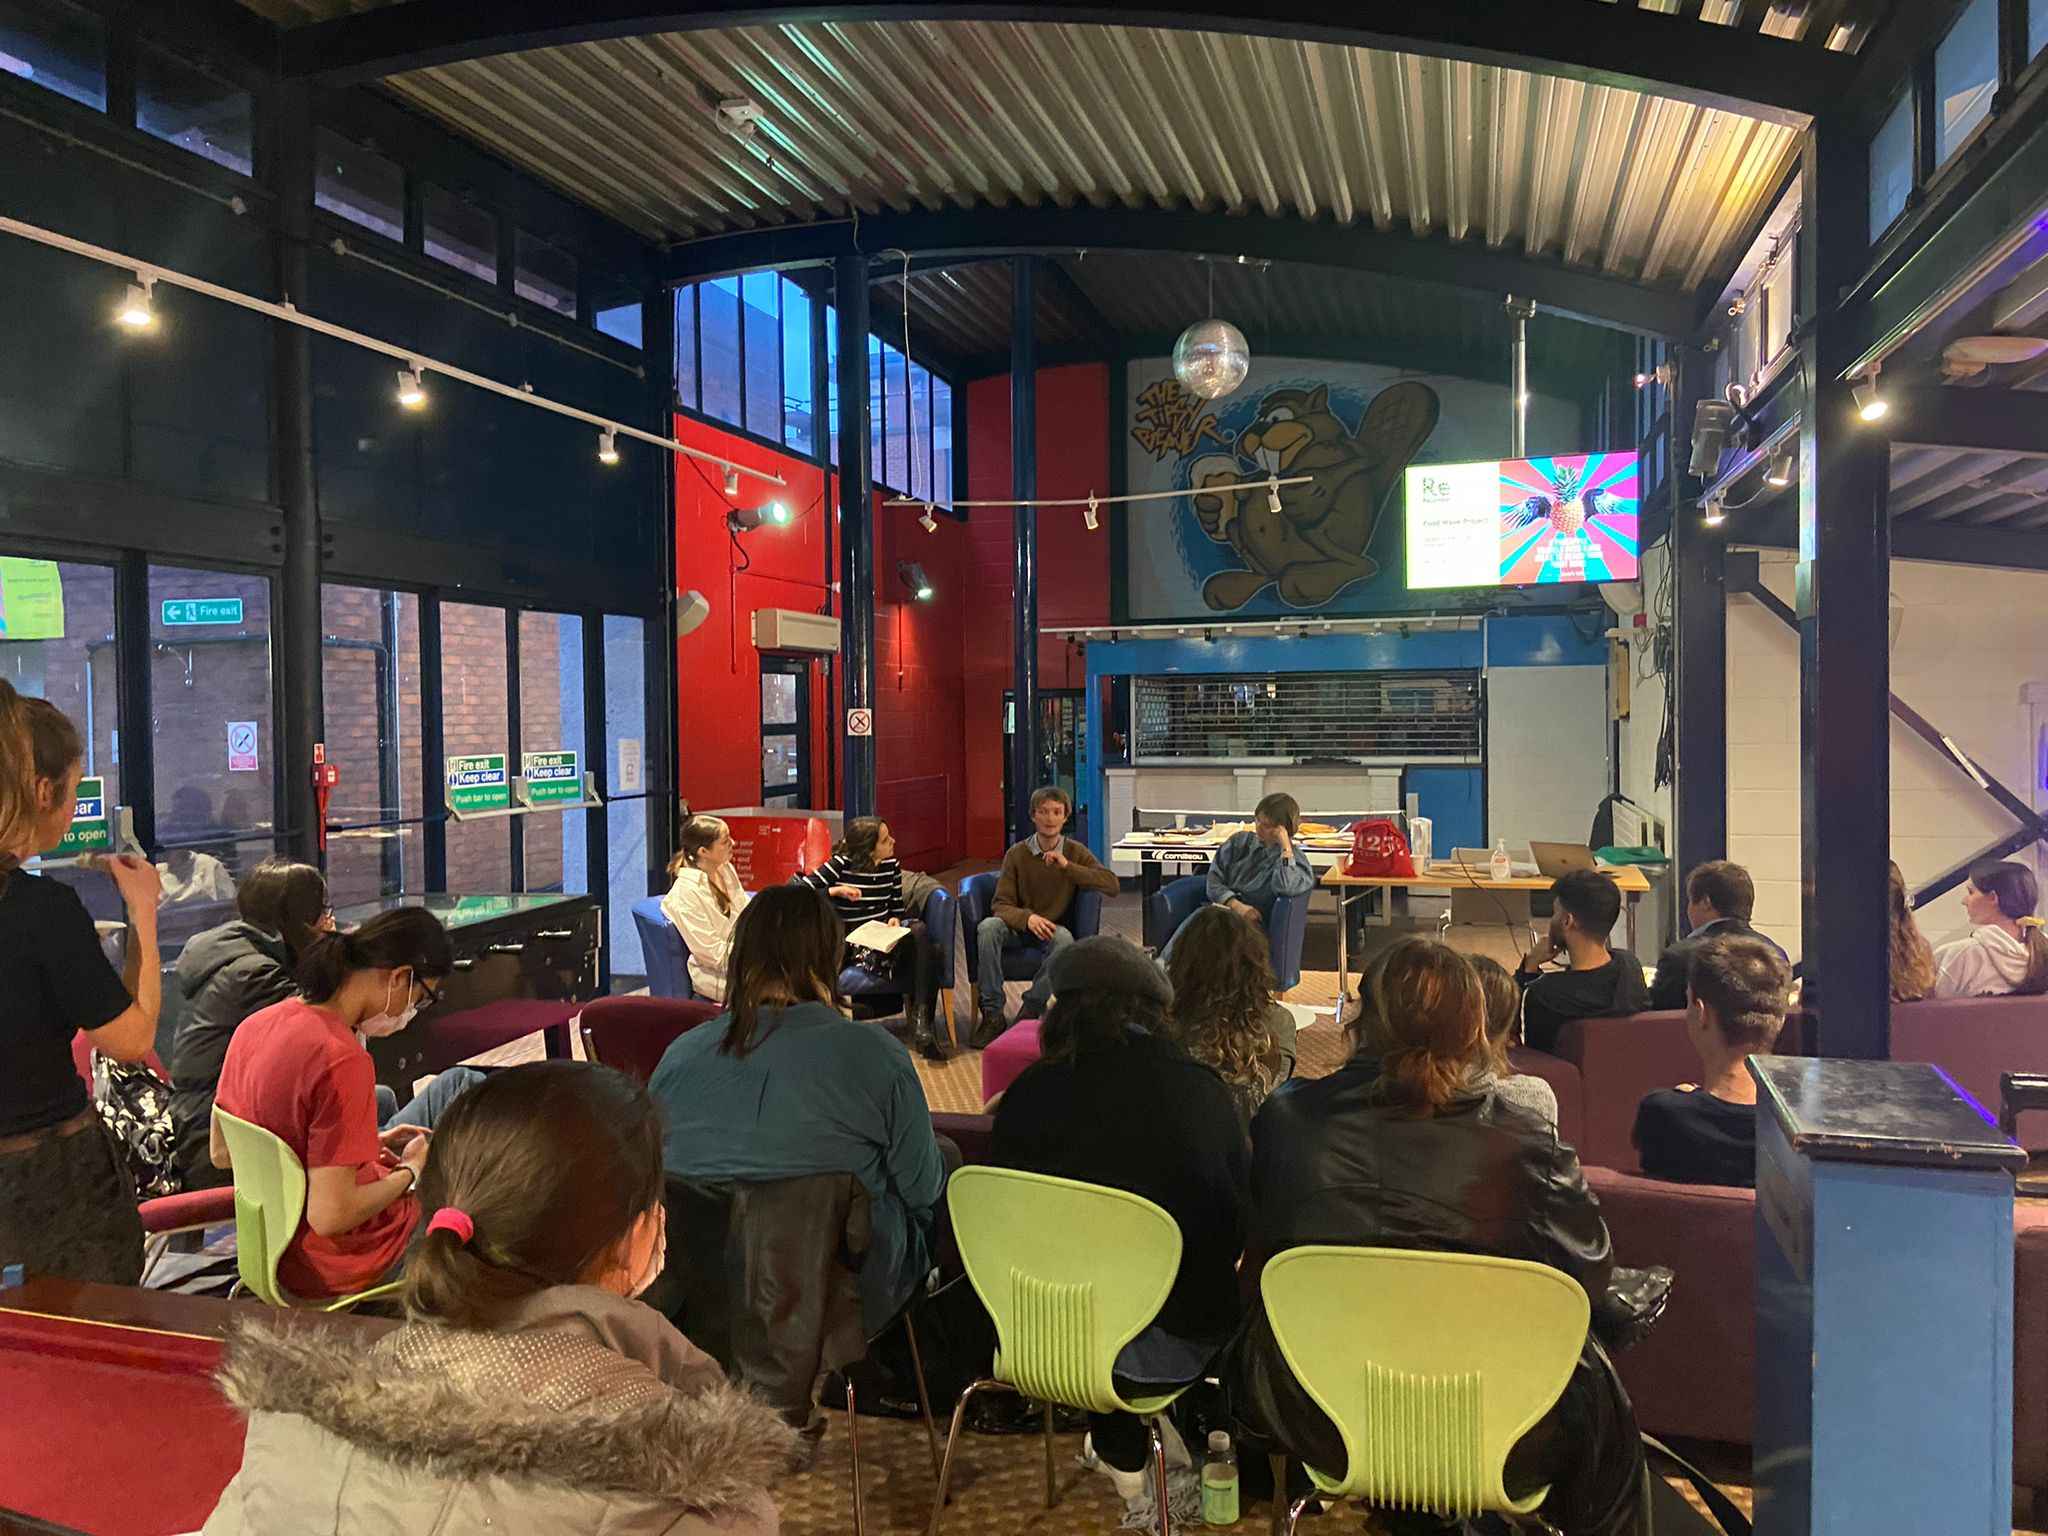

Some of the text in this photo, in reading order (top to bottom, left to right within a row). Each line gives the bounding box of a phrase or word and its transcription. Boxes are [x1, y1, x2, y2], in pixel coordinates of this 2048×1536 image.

[1137, 379, 1181, 408] THE
[1131, 413, 1227, 461] BEAVER
[200, 604, 238, 617] Fire exit
[459, 758, 490, 770] Fire exit
[533, 755, 562, 766] Fire exit
[459, 771, 501, 784] Keep clear
[533, 766, 571, 778] Keep clear
[473, 794, 483, 802] bar
[484, 793, 490, 801] to
[492, 793, 507, 802] open
[63, 829, 107, 842] to open
